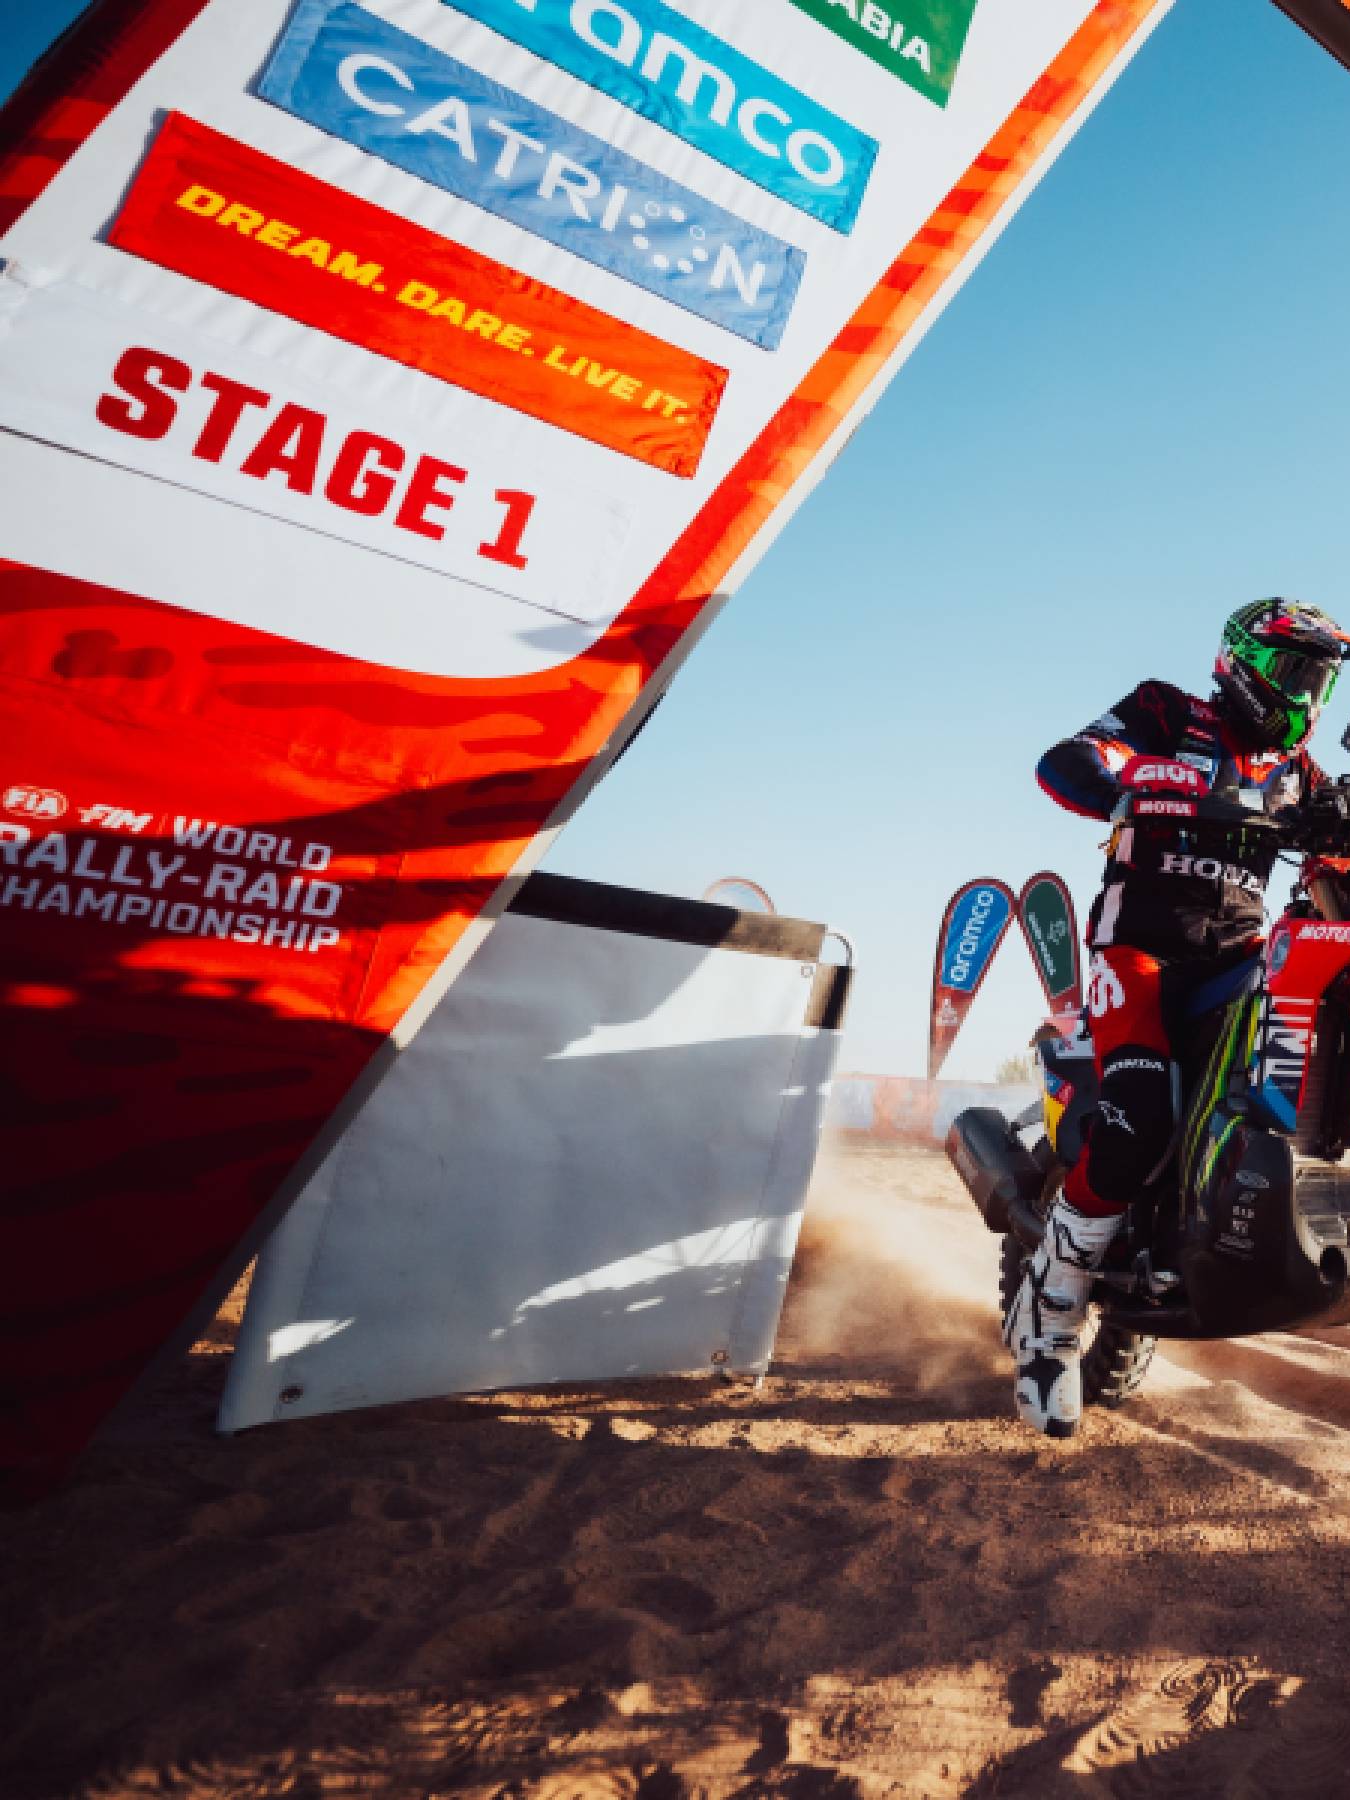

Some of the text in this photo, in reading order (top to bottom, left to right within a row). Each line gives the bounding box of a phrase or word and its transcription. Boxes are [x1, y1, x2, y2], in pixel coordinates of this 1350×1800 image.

[513, 0, 845, 186] amco
[176, 183, 688, 424] DREAM. DARE. LIVE IT.
[96, 345, 536, 570] STAGE 1
[4, 787, 59, 815] FIA
[174, 815, 332, 871] WORLD
[0, 874, 340, 952] HAMPIONSHIP
[950, 890, 994, 982] aramco
